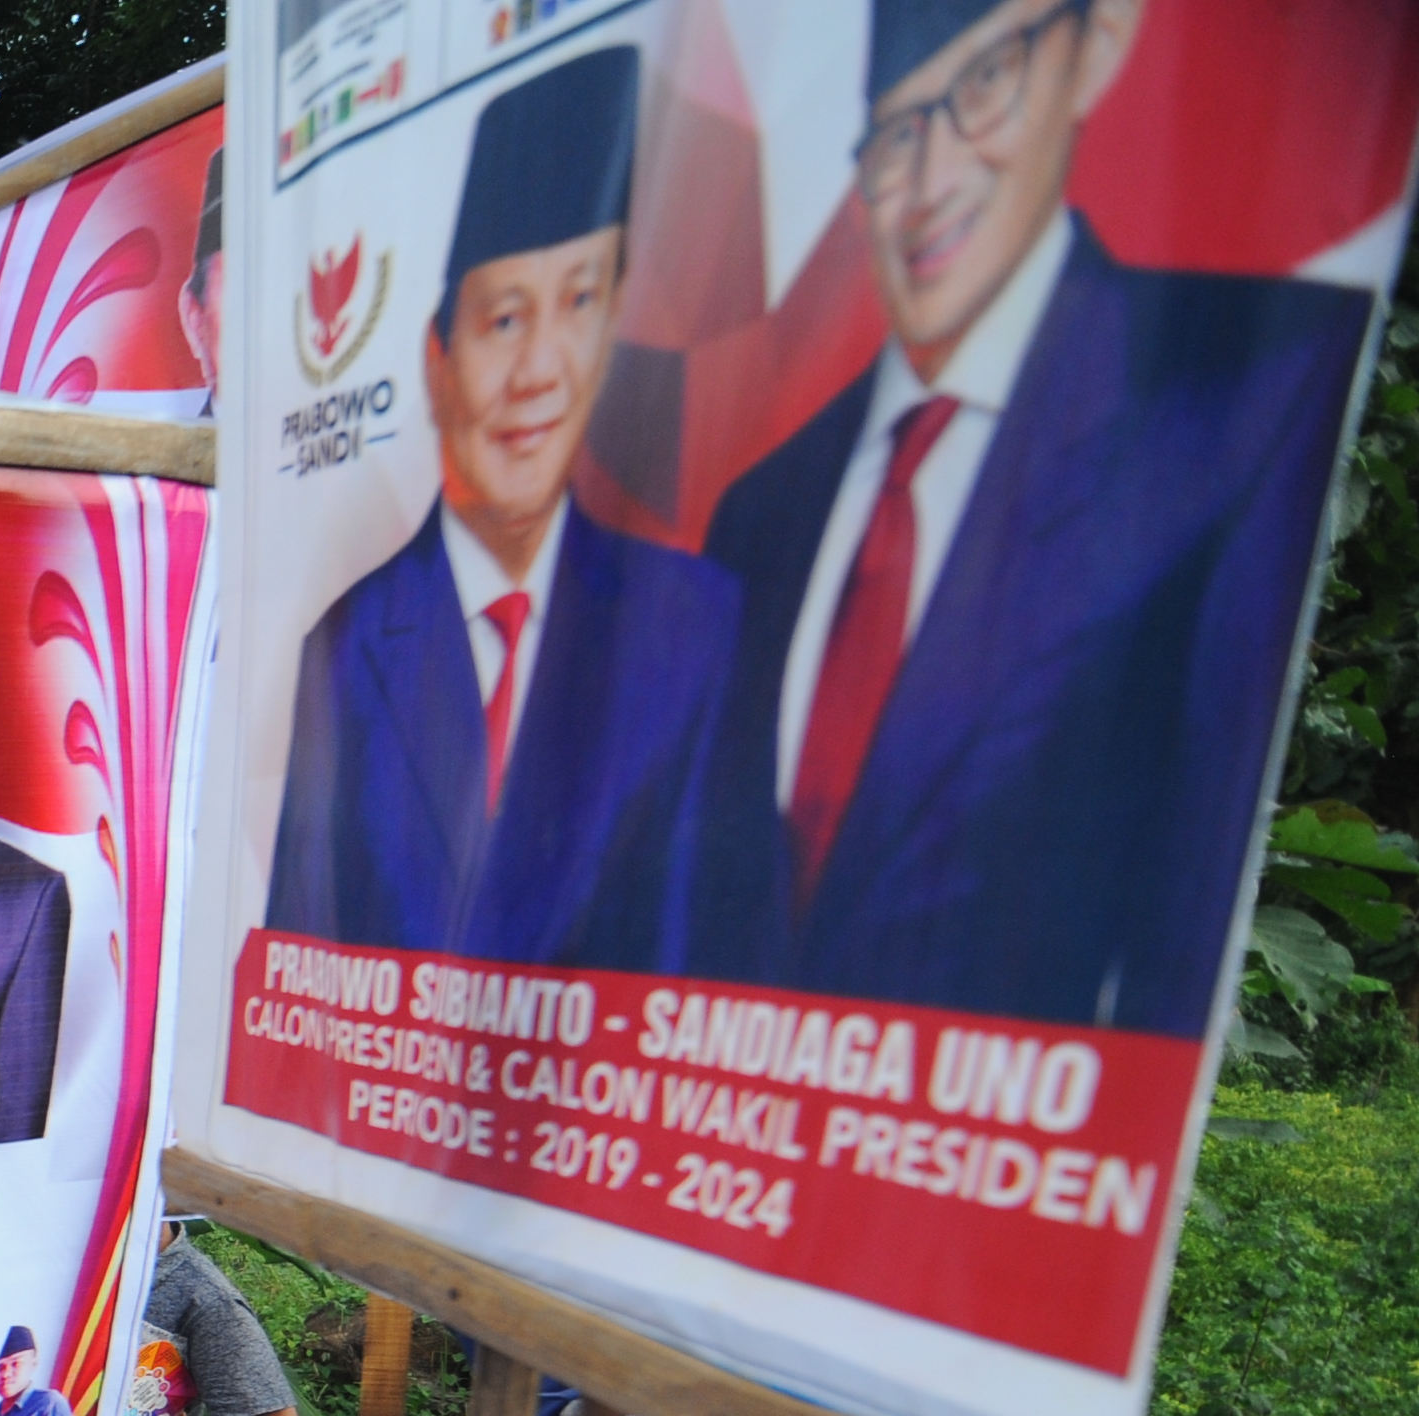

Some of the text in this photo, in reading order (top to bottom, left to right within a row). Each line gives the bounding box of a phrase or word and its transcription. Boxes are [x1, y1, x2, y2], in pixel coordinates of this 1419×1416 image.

[281, 379, 393, 448] PRABOWO
[297, 427, 361, 477] SANDI
[244, 996, 1159, 1236] CALON PRESIDEN & CALON WAKIL PRESIDEN
[638, 988, 917, 1104] SANDIAGA
[928, 1026, 1102, 1134] UNO
[530, 1121, 639, 1190] 2019
[667, 1153, 795, 1238] 2024
